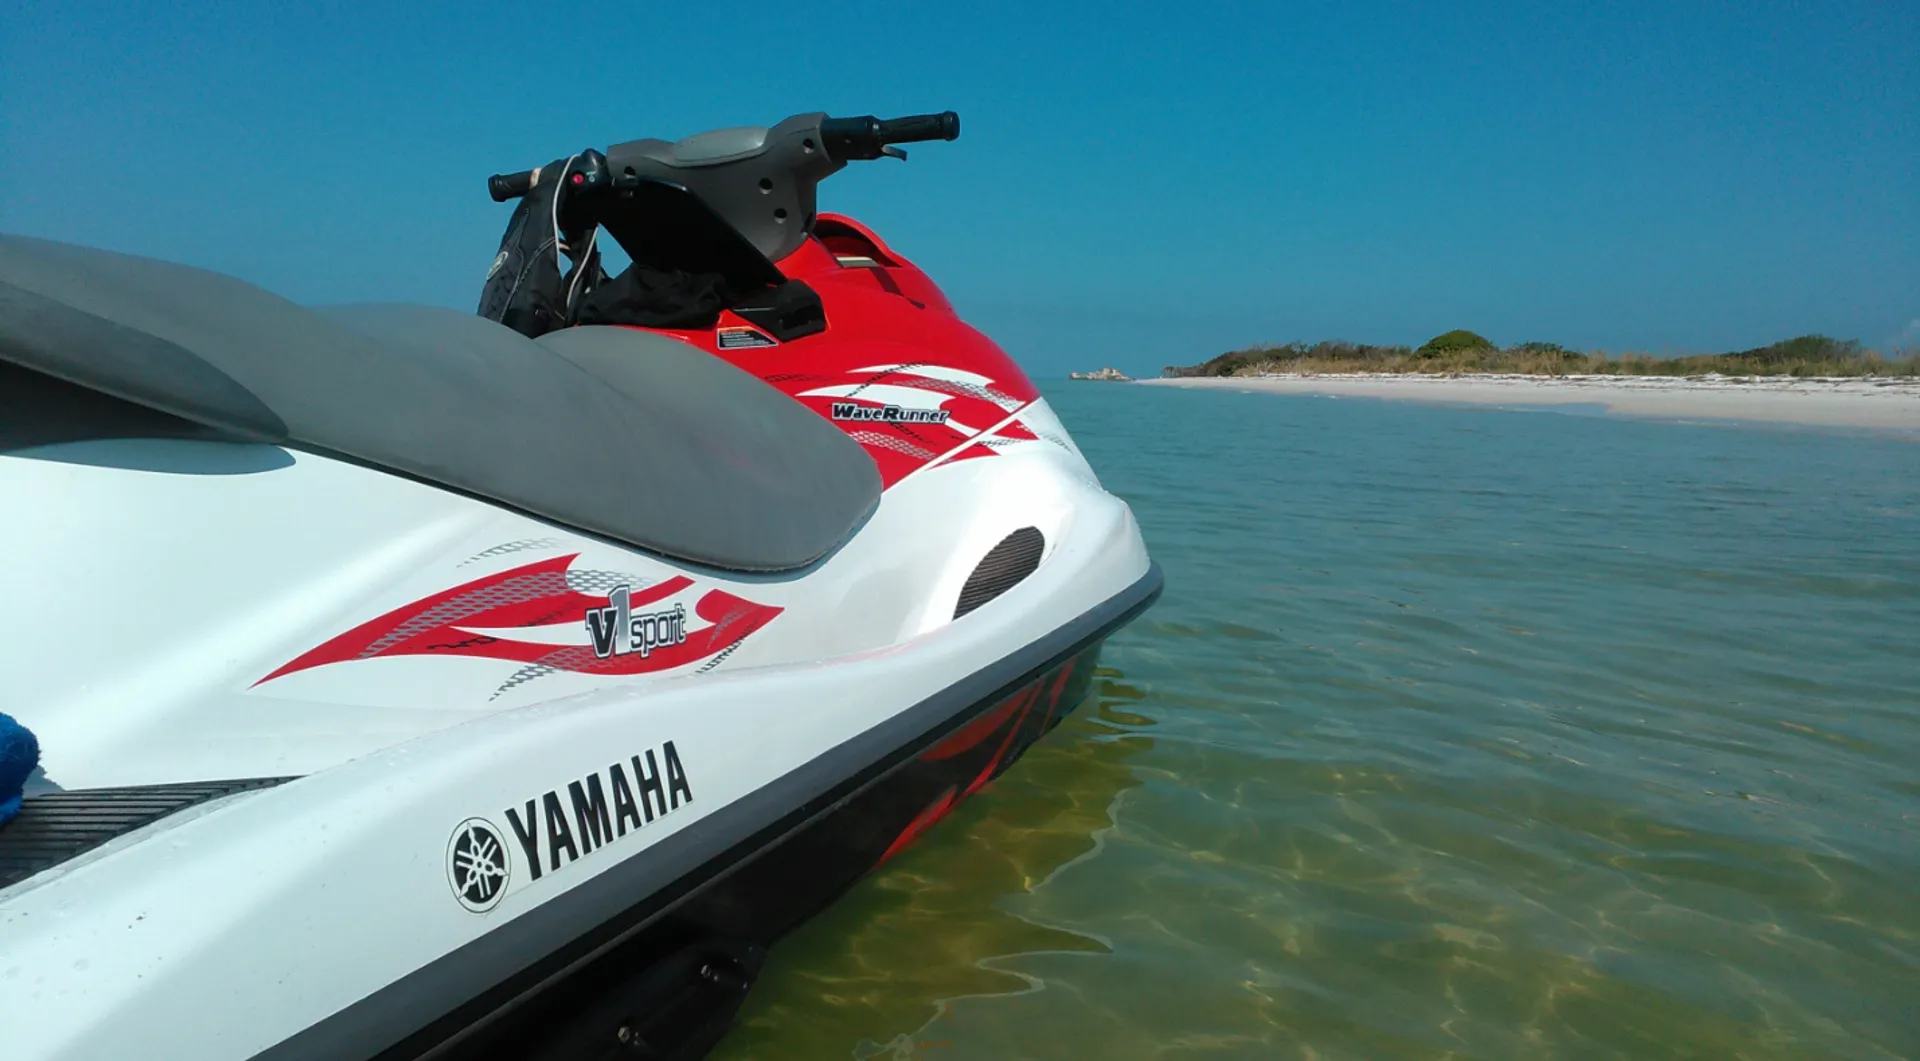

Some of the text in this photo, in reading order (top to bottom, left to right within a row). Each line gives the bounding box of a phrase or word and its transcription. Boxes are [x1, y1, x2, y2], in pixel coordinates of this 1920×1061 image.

[832, 403, 950, 423] WaveRunner
[630, 603, 686, 659] sport
[504, 740, 693, 882] YAMAHA
